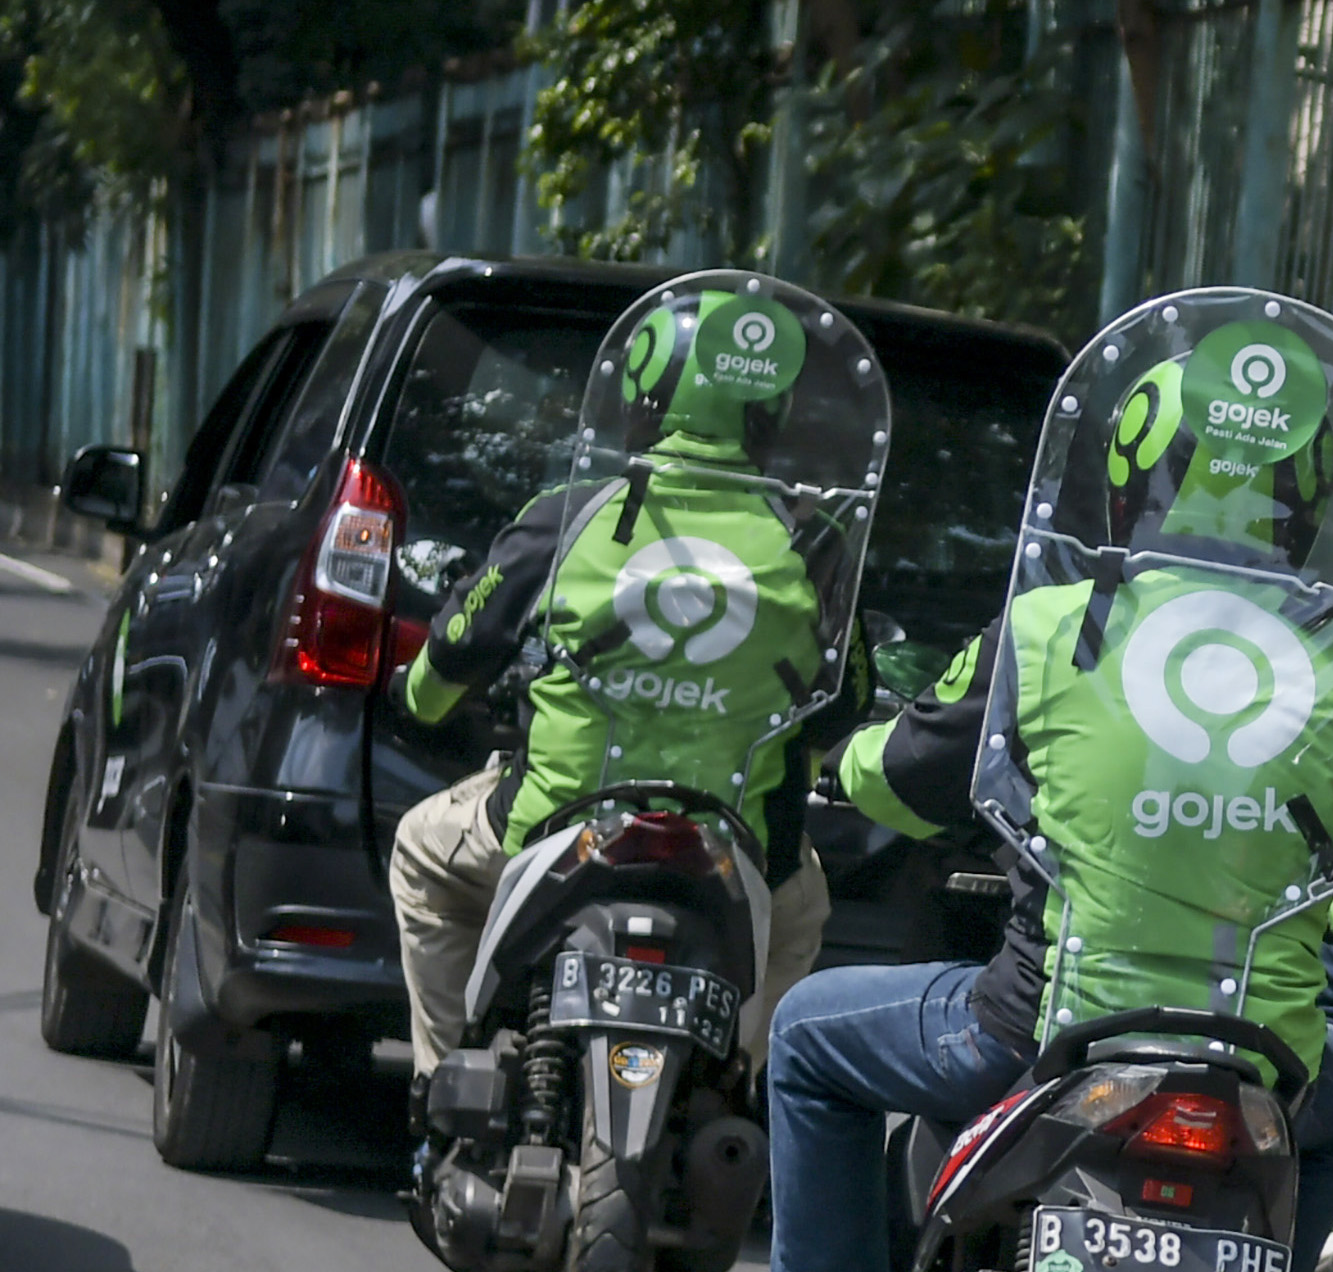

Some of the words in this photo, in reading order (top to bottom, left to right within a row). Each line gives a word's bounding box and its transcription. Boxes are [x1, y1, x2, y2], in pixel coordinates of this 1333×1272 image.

[716, 353, 778, 376] gojek
[1205, 425, 1233, 438] Pasti
[1235, 432, 1256, 444] Ada
[1258, 437, 1287, 450] Jalan
[1208, 400, 1291, 431] gojek
[1209, 459, 1259, 478] gojek
[464, 563, 504, 627] gojek
[603, 668, 731, 714] gojek
[1132, 787, 1299, 840] gojek
[563, 958, 579, 988] B
[600, 962, 673, 996] 3226
[688, 974, 733, 1018] PES
[1040, 1214, 1062, 1254] B
[1084, 1218, 1181, 1267] 3538
